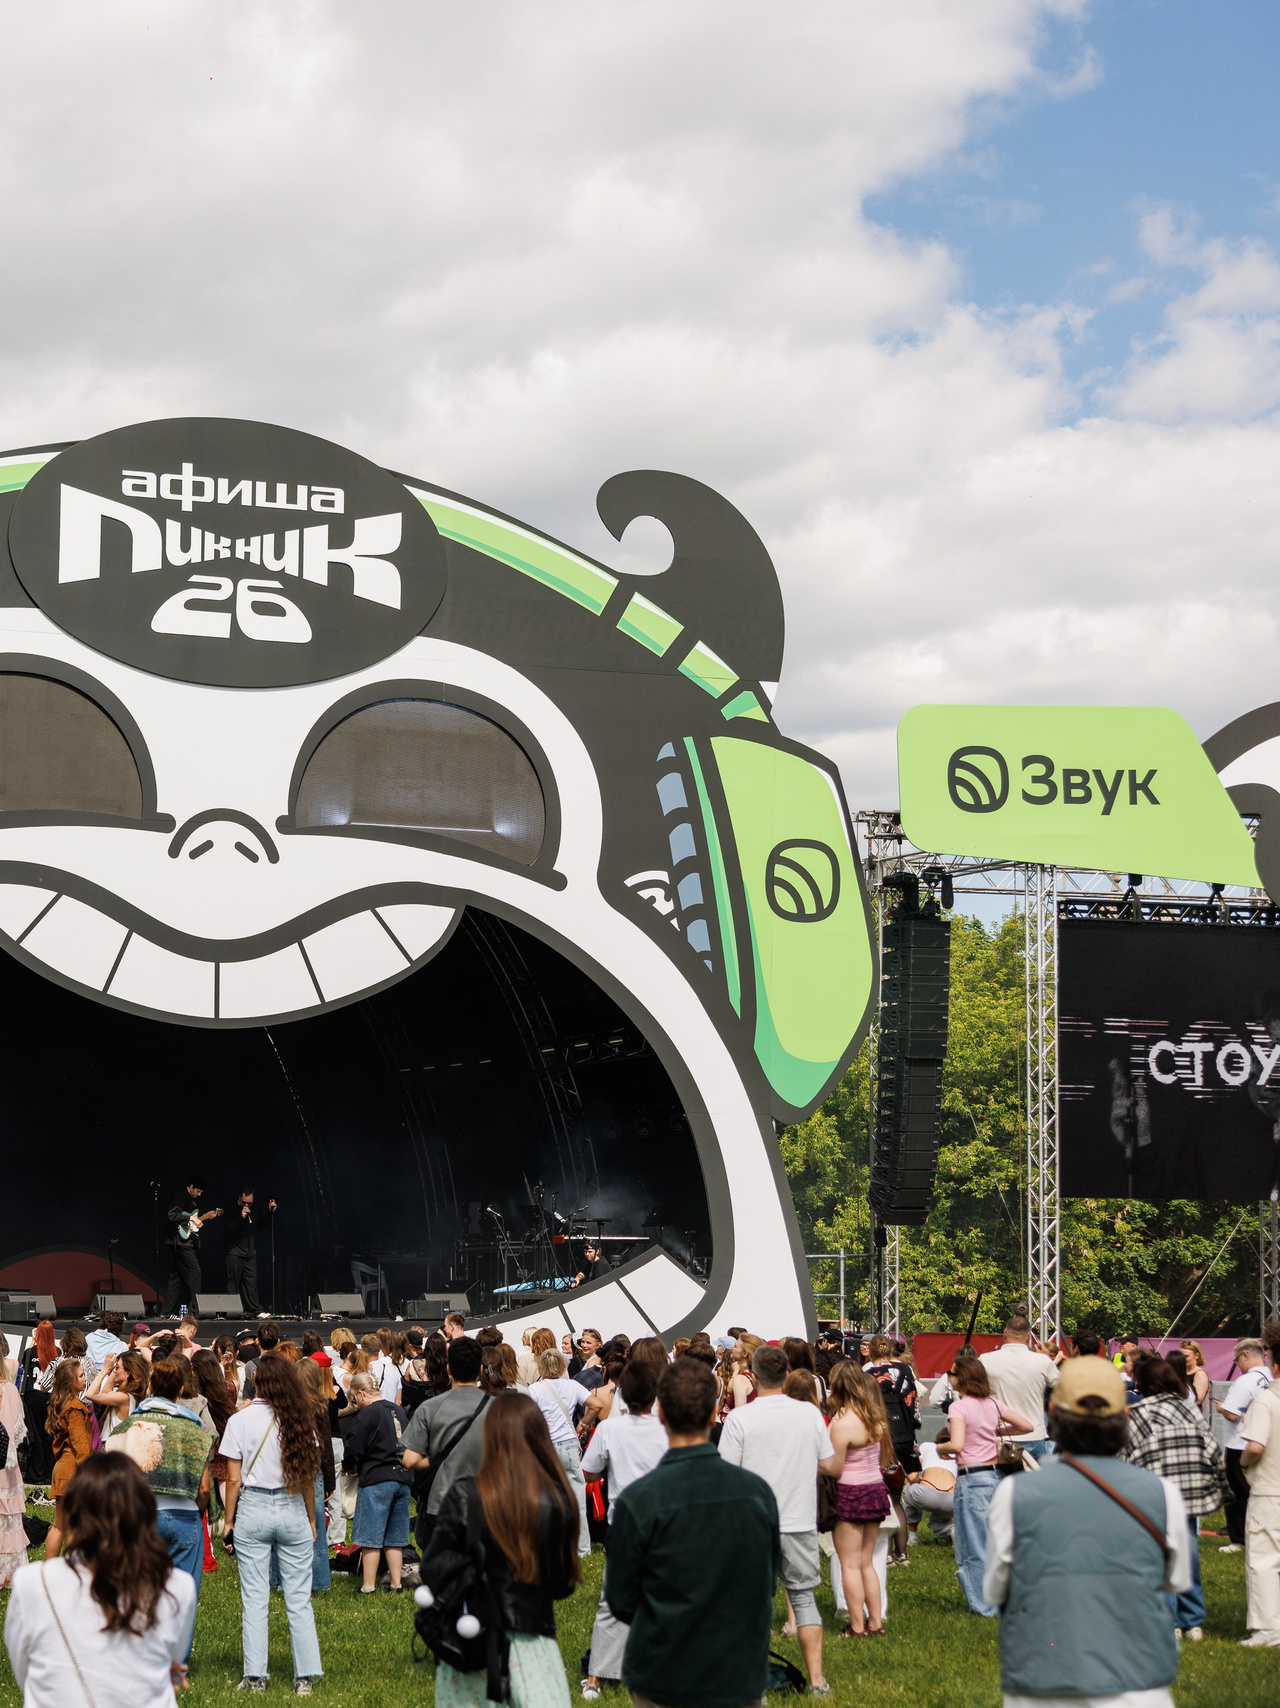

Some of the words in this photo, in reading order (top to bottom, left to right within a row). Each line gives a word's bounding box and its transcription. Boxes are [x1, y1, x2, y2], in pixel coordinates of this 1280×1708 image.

[122, 462, 345, 514] афиша
[150, 574, 313, 644] 26
[1021, 754, 1161, 816] Звук
